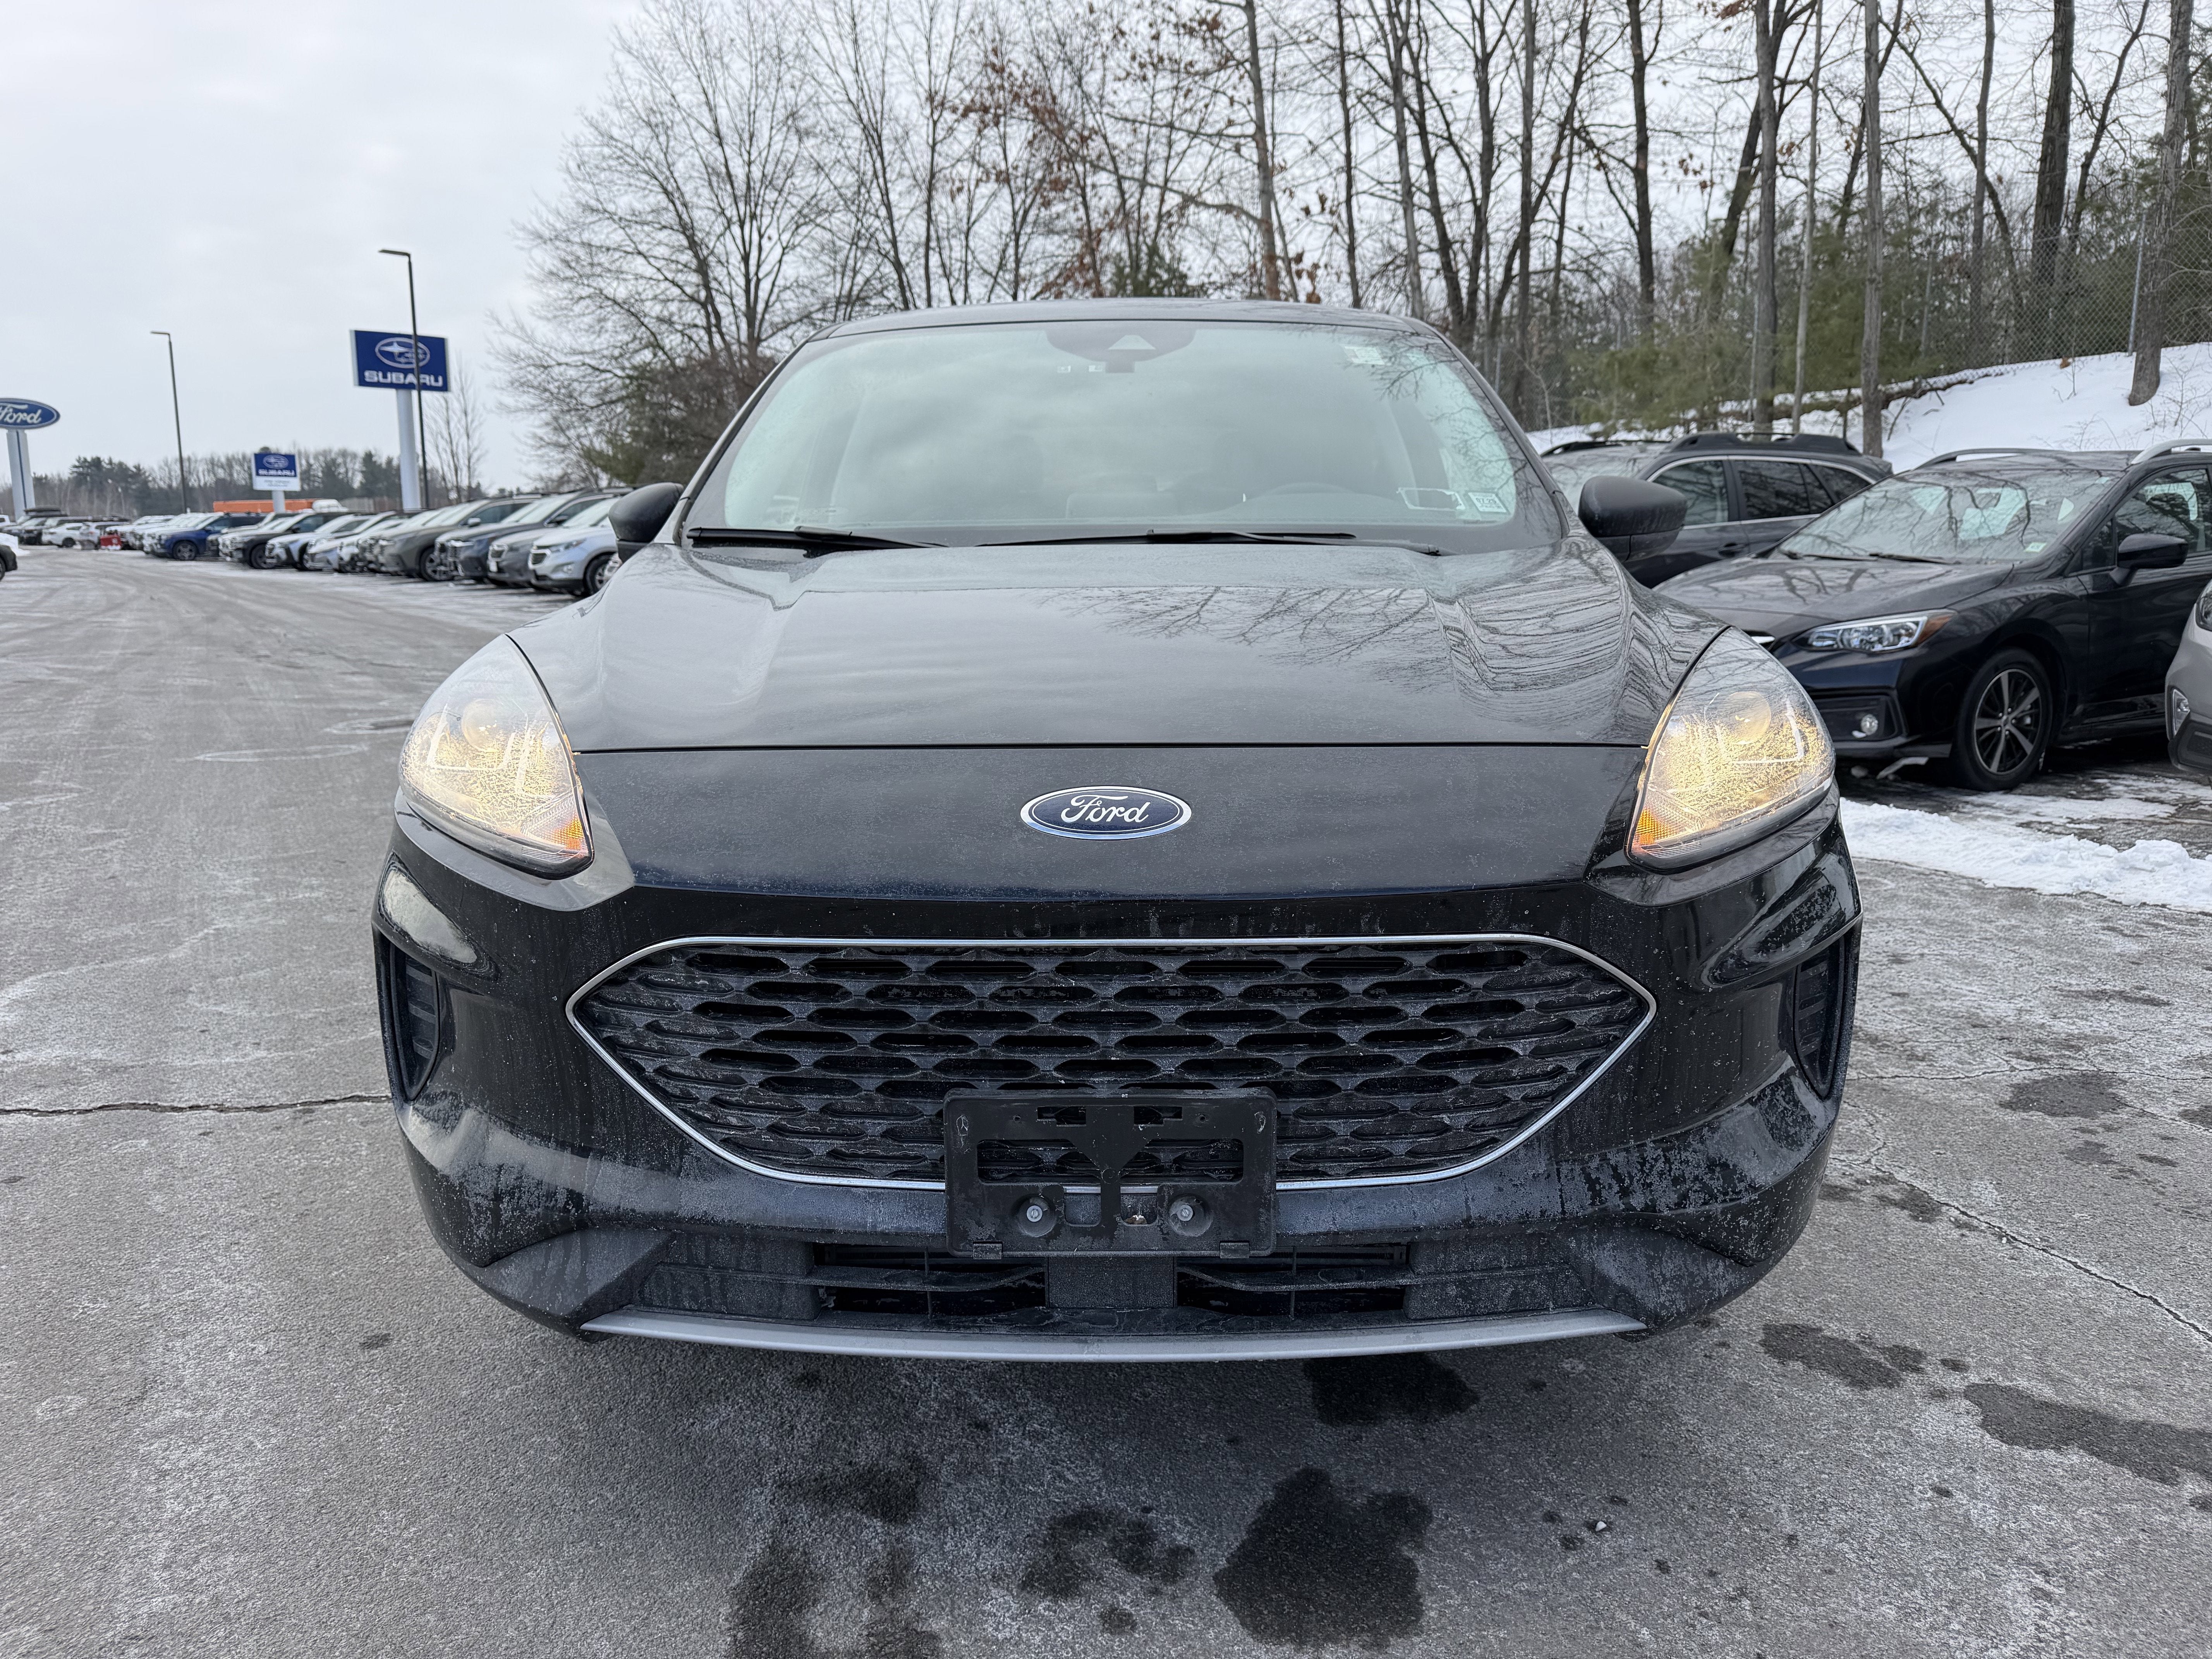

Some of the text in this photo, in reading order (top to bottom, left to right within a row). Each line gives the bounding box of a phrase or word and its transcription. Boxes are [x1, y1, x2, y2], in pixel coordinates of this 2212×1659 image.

[364, 370, 443, 387] SUBARU
[0, 402, 42, 424] Ford
[1061, 794, 1151, 823] Ford
